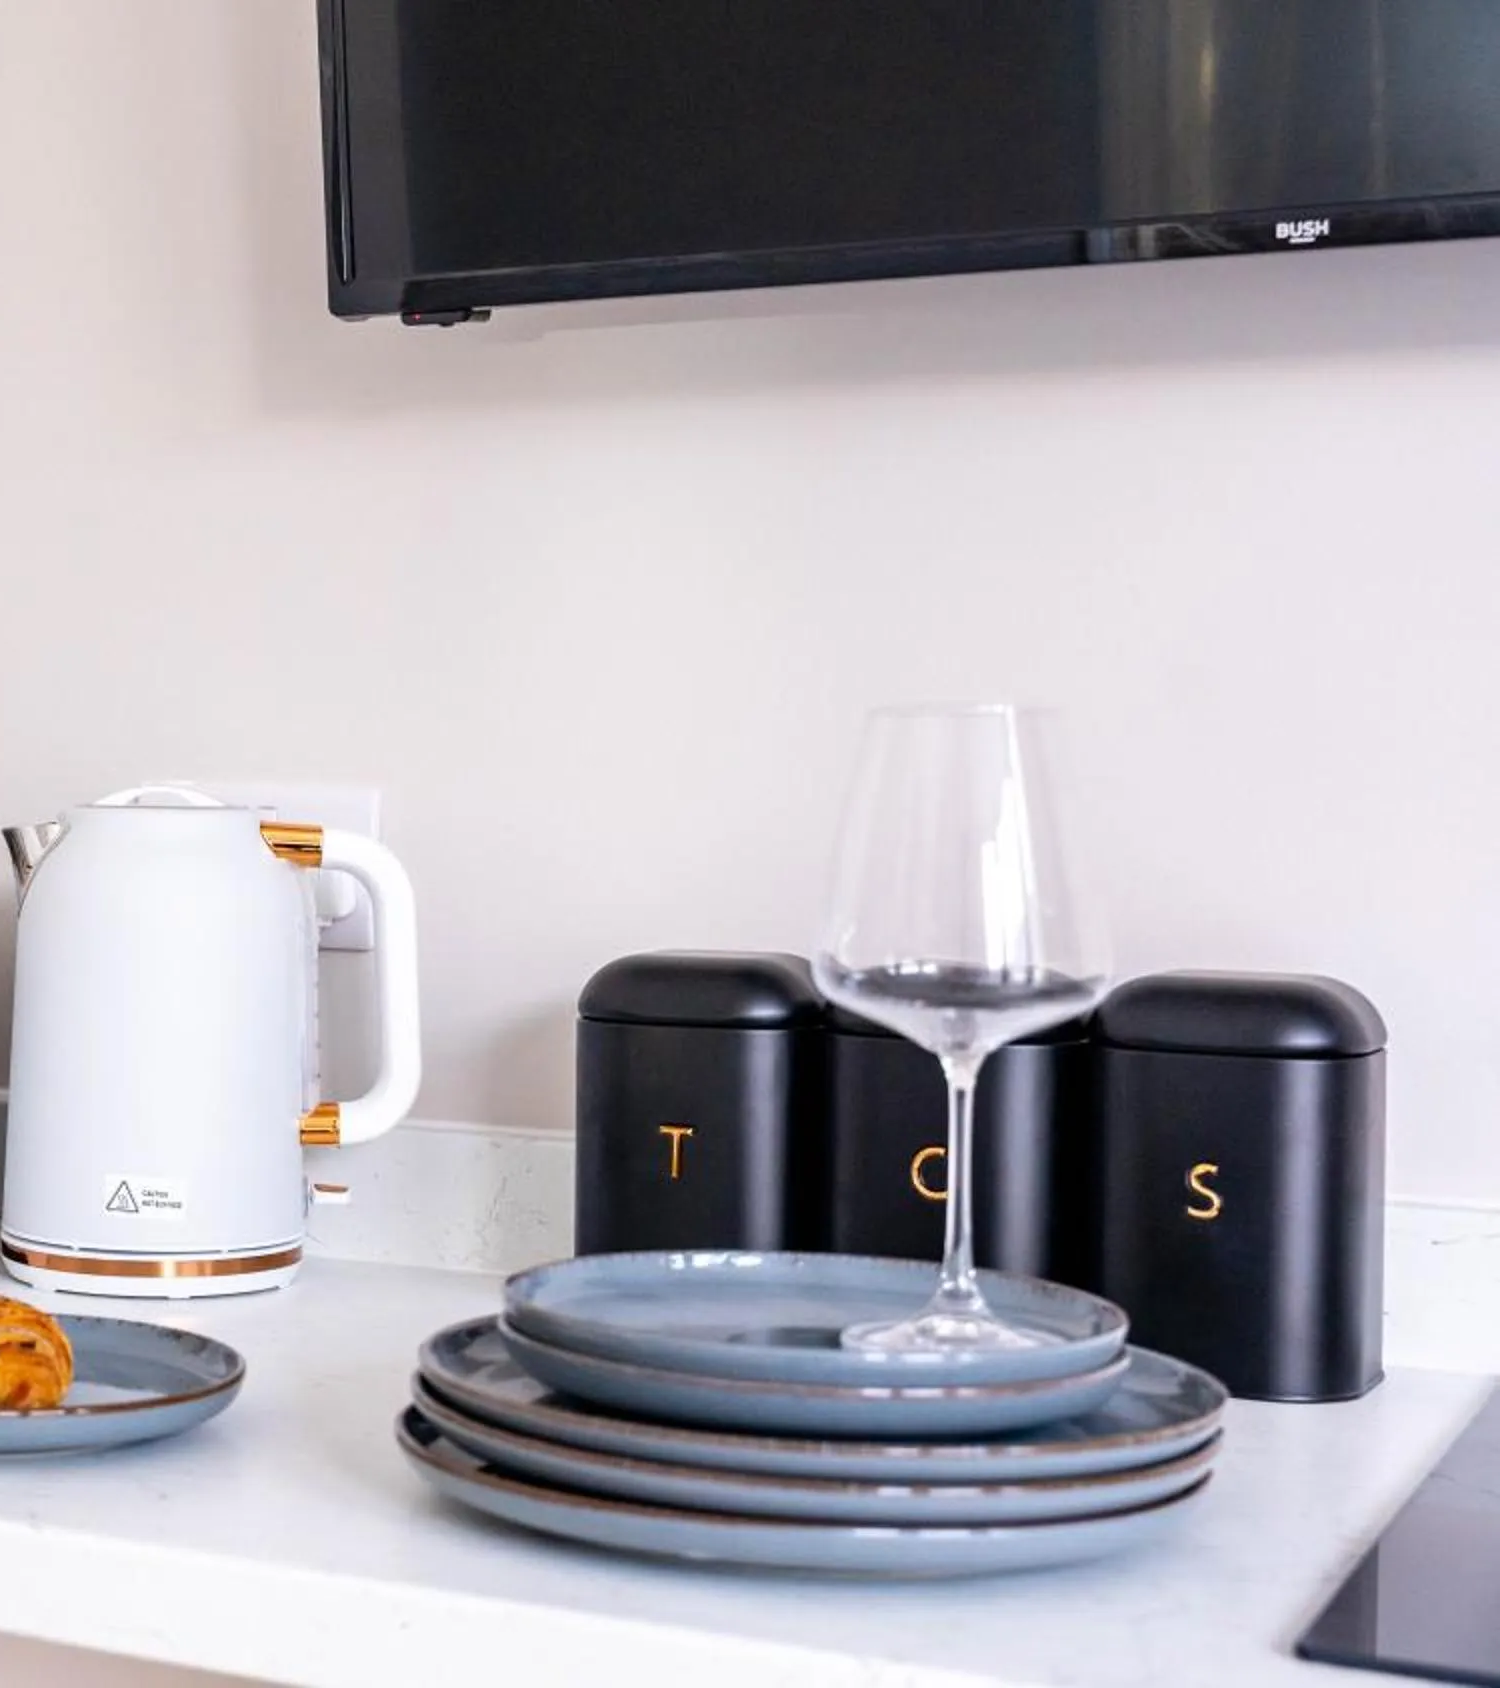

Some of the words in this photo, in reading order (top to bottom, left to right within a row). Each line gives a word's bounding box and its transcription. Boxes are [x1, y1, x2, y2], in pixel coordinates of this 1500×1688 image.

[1275, 218, 1330, 239] BUSH
[659, 1124, 694, 1180] T
[1187, 1163, 1223, 1220] S
